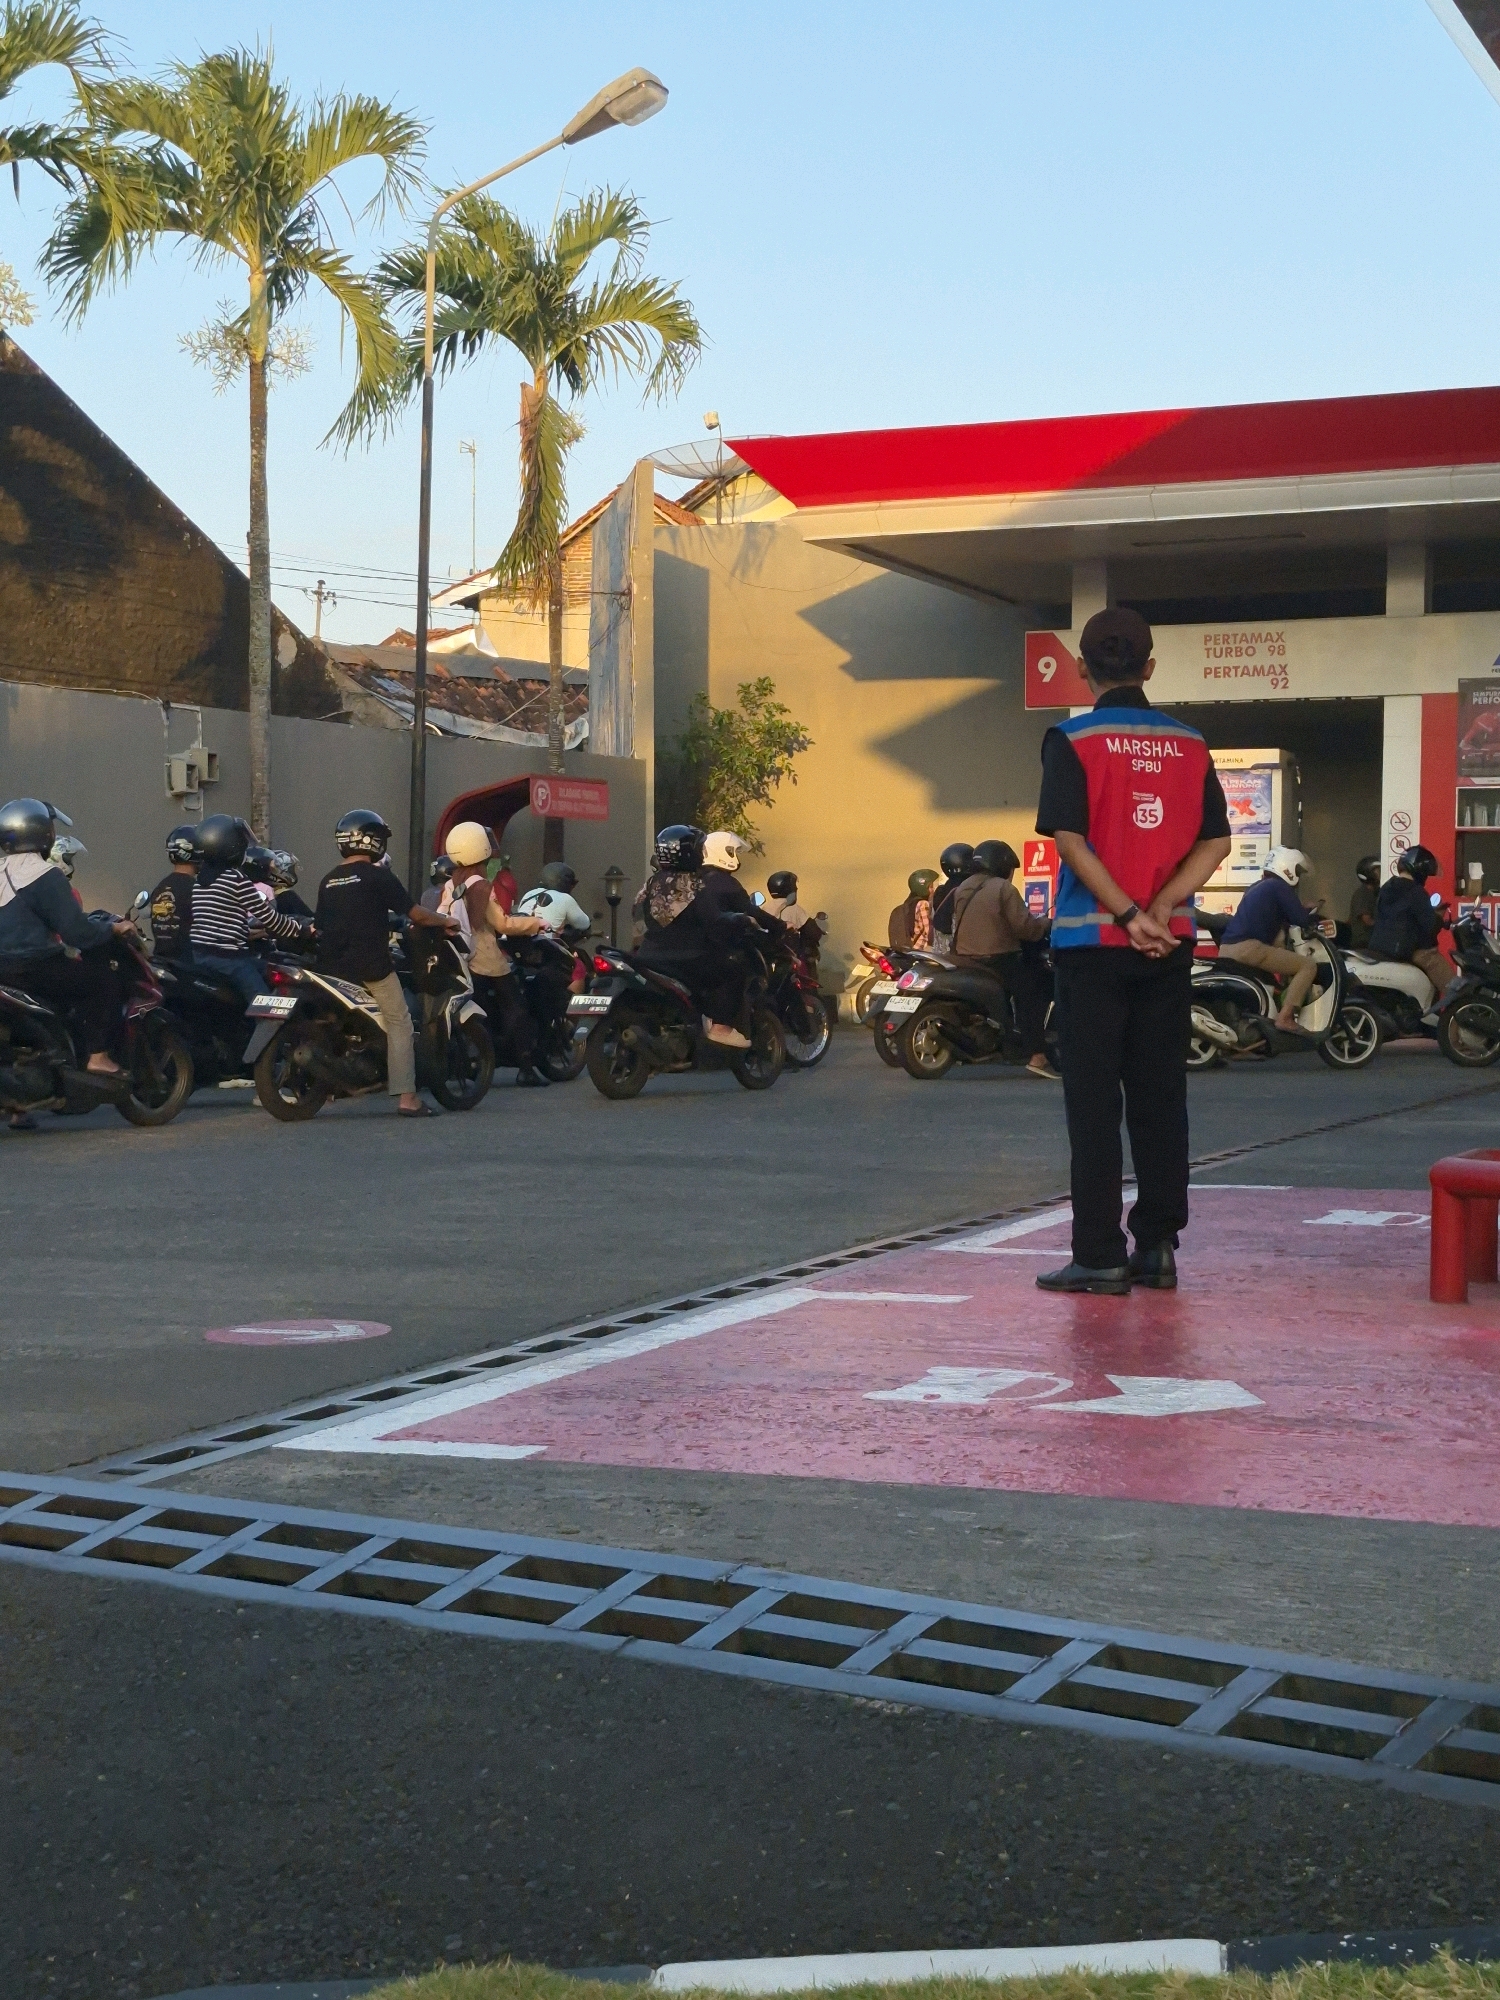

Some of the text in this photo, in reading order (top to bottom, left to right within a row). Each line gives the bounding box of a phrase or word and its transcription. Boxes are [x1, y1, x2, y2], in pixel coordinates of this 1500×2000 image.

[1203, 631, 1285, 645] PERTAMAX
[1204, 644, 1286, 659] TURBO 98
[1037, 656, 1057, 683] 9
[1203, 663, 1289, 679] PERTAMAX
[1270, 677, 1289, 690] 92
[1105, 737, 1184, 758] MARSHAL
[1131, 758, 1162, 773] SPBU
[1135, 808, 1159, 824] 135
